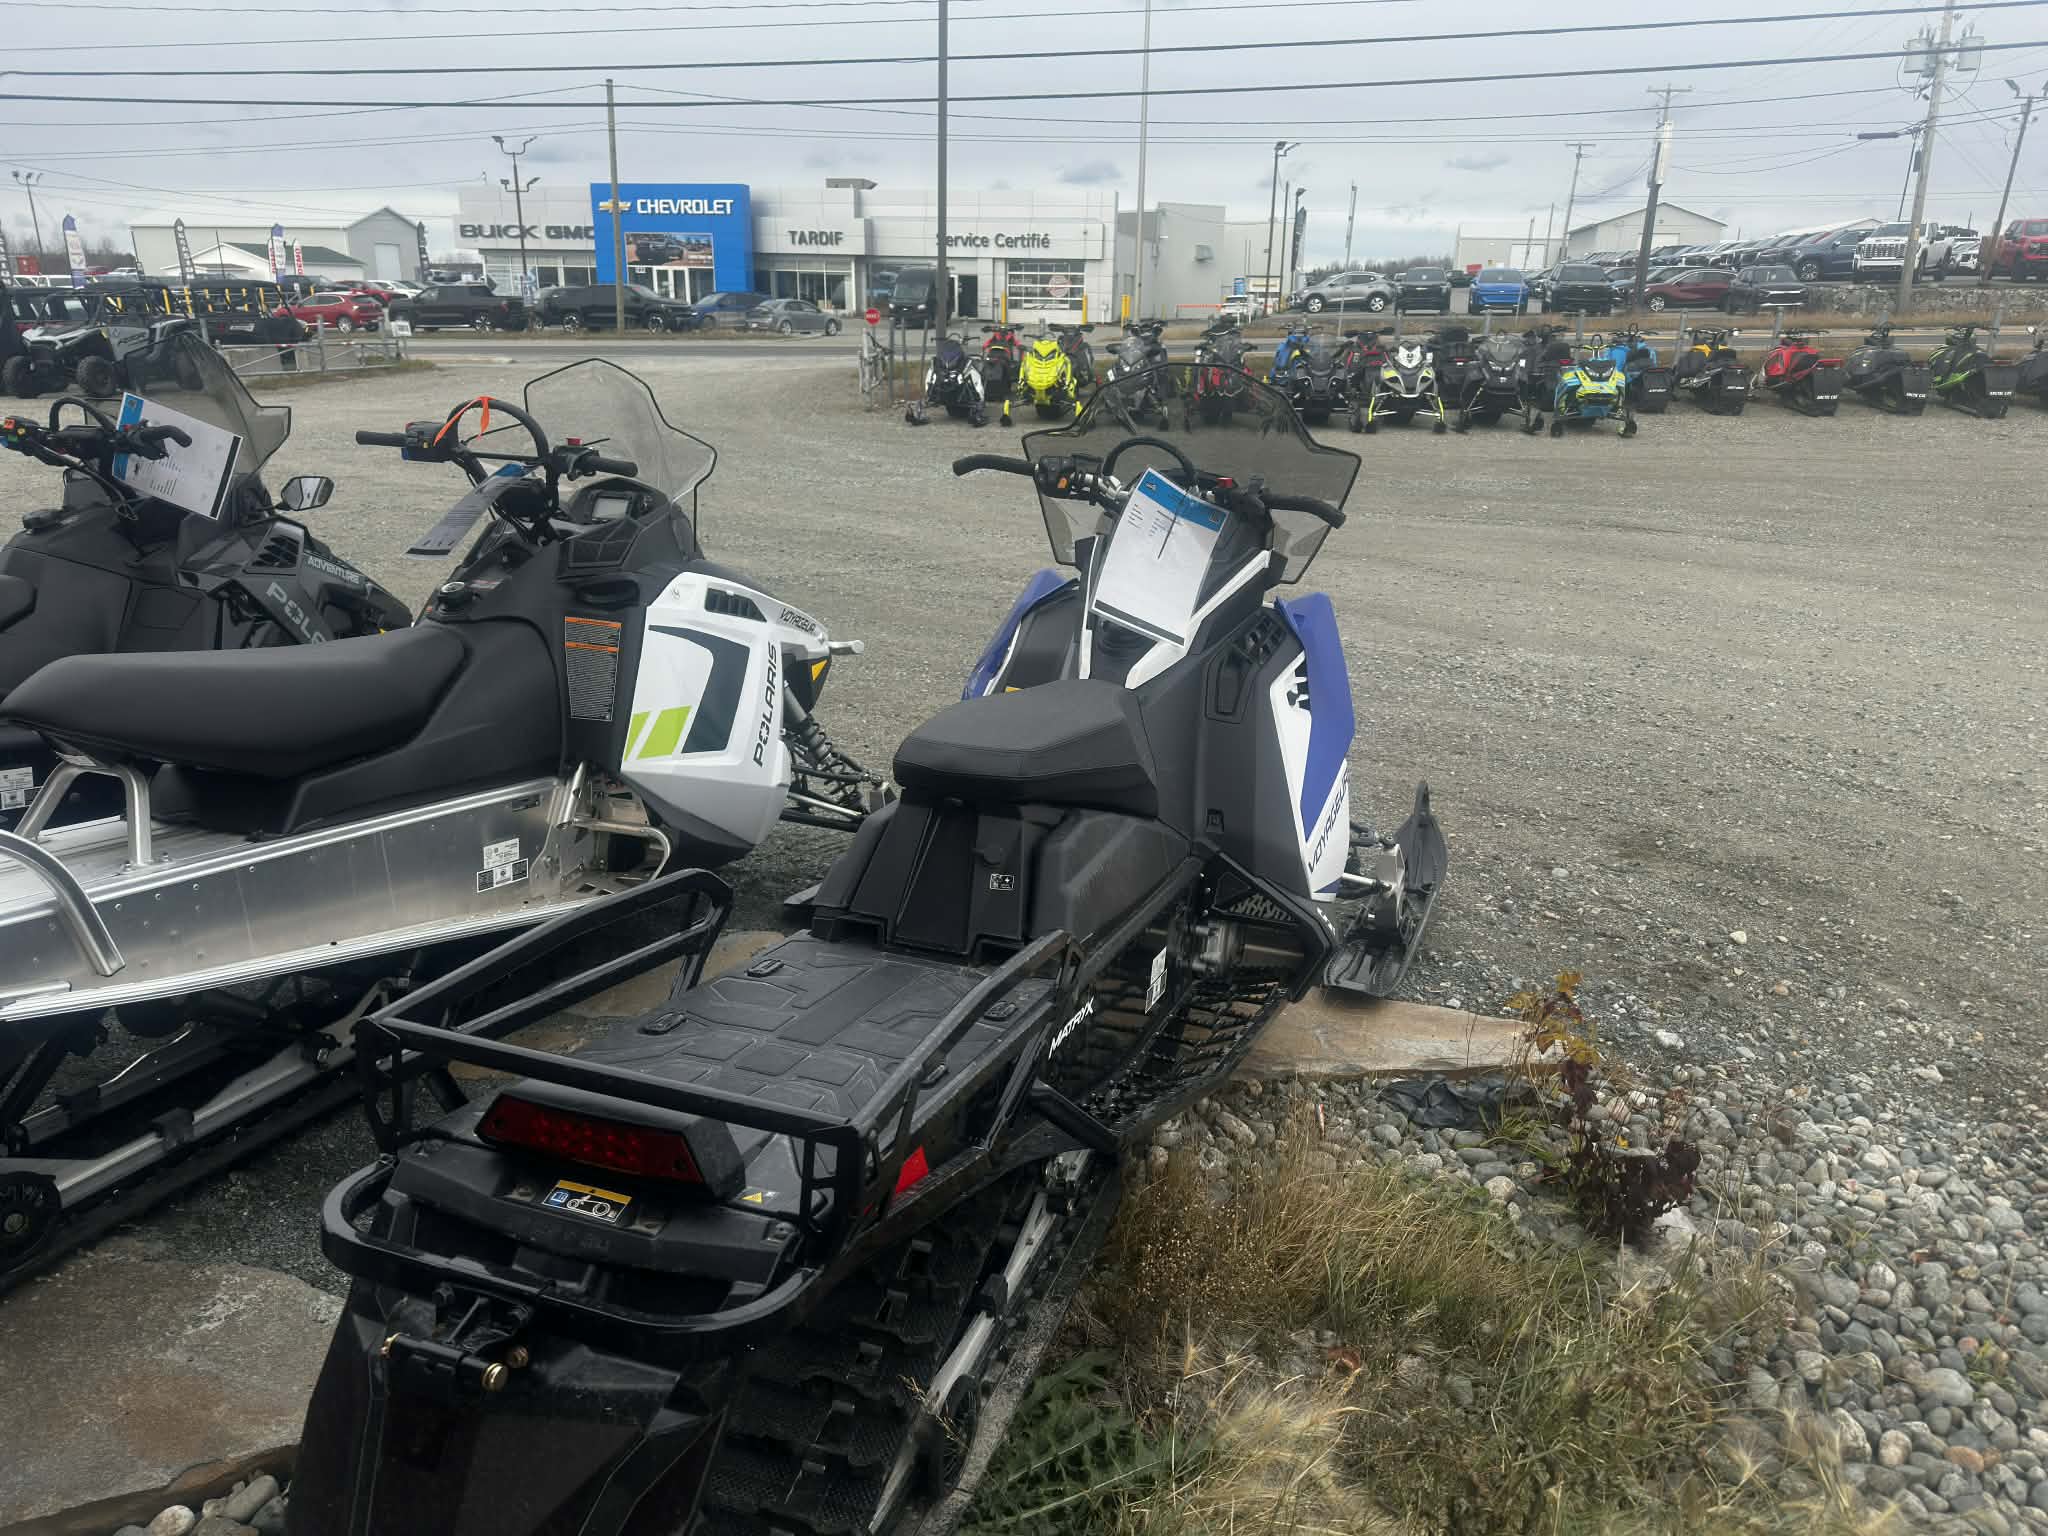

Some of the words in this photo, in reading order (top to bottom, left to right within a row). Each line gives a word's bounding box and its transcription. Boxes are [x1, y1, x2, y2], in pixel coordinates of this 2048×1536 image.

[637, 199, 734, 215] CHEVROLET
[459, 224, 540, 239] BUICK
[788, 230, 843, 246] TARDIF
[936, 232, 990, 249] ervice
[994, 232, 1051, 249] Certifié
[307, 556, 360, 585] ADVENTURE
[753, 641, 777, 768] POLARIS
[1048, 995, 1095, 1061] MATRYX
